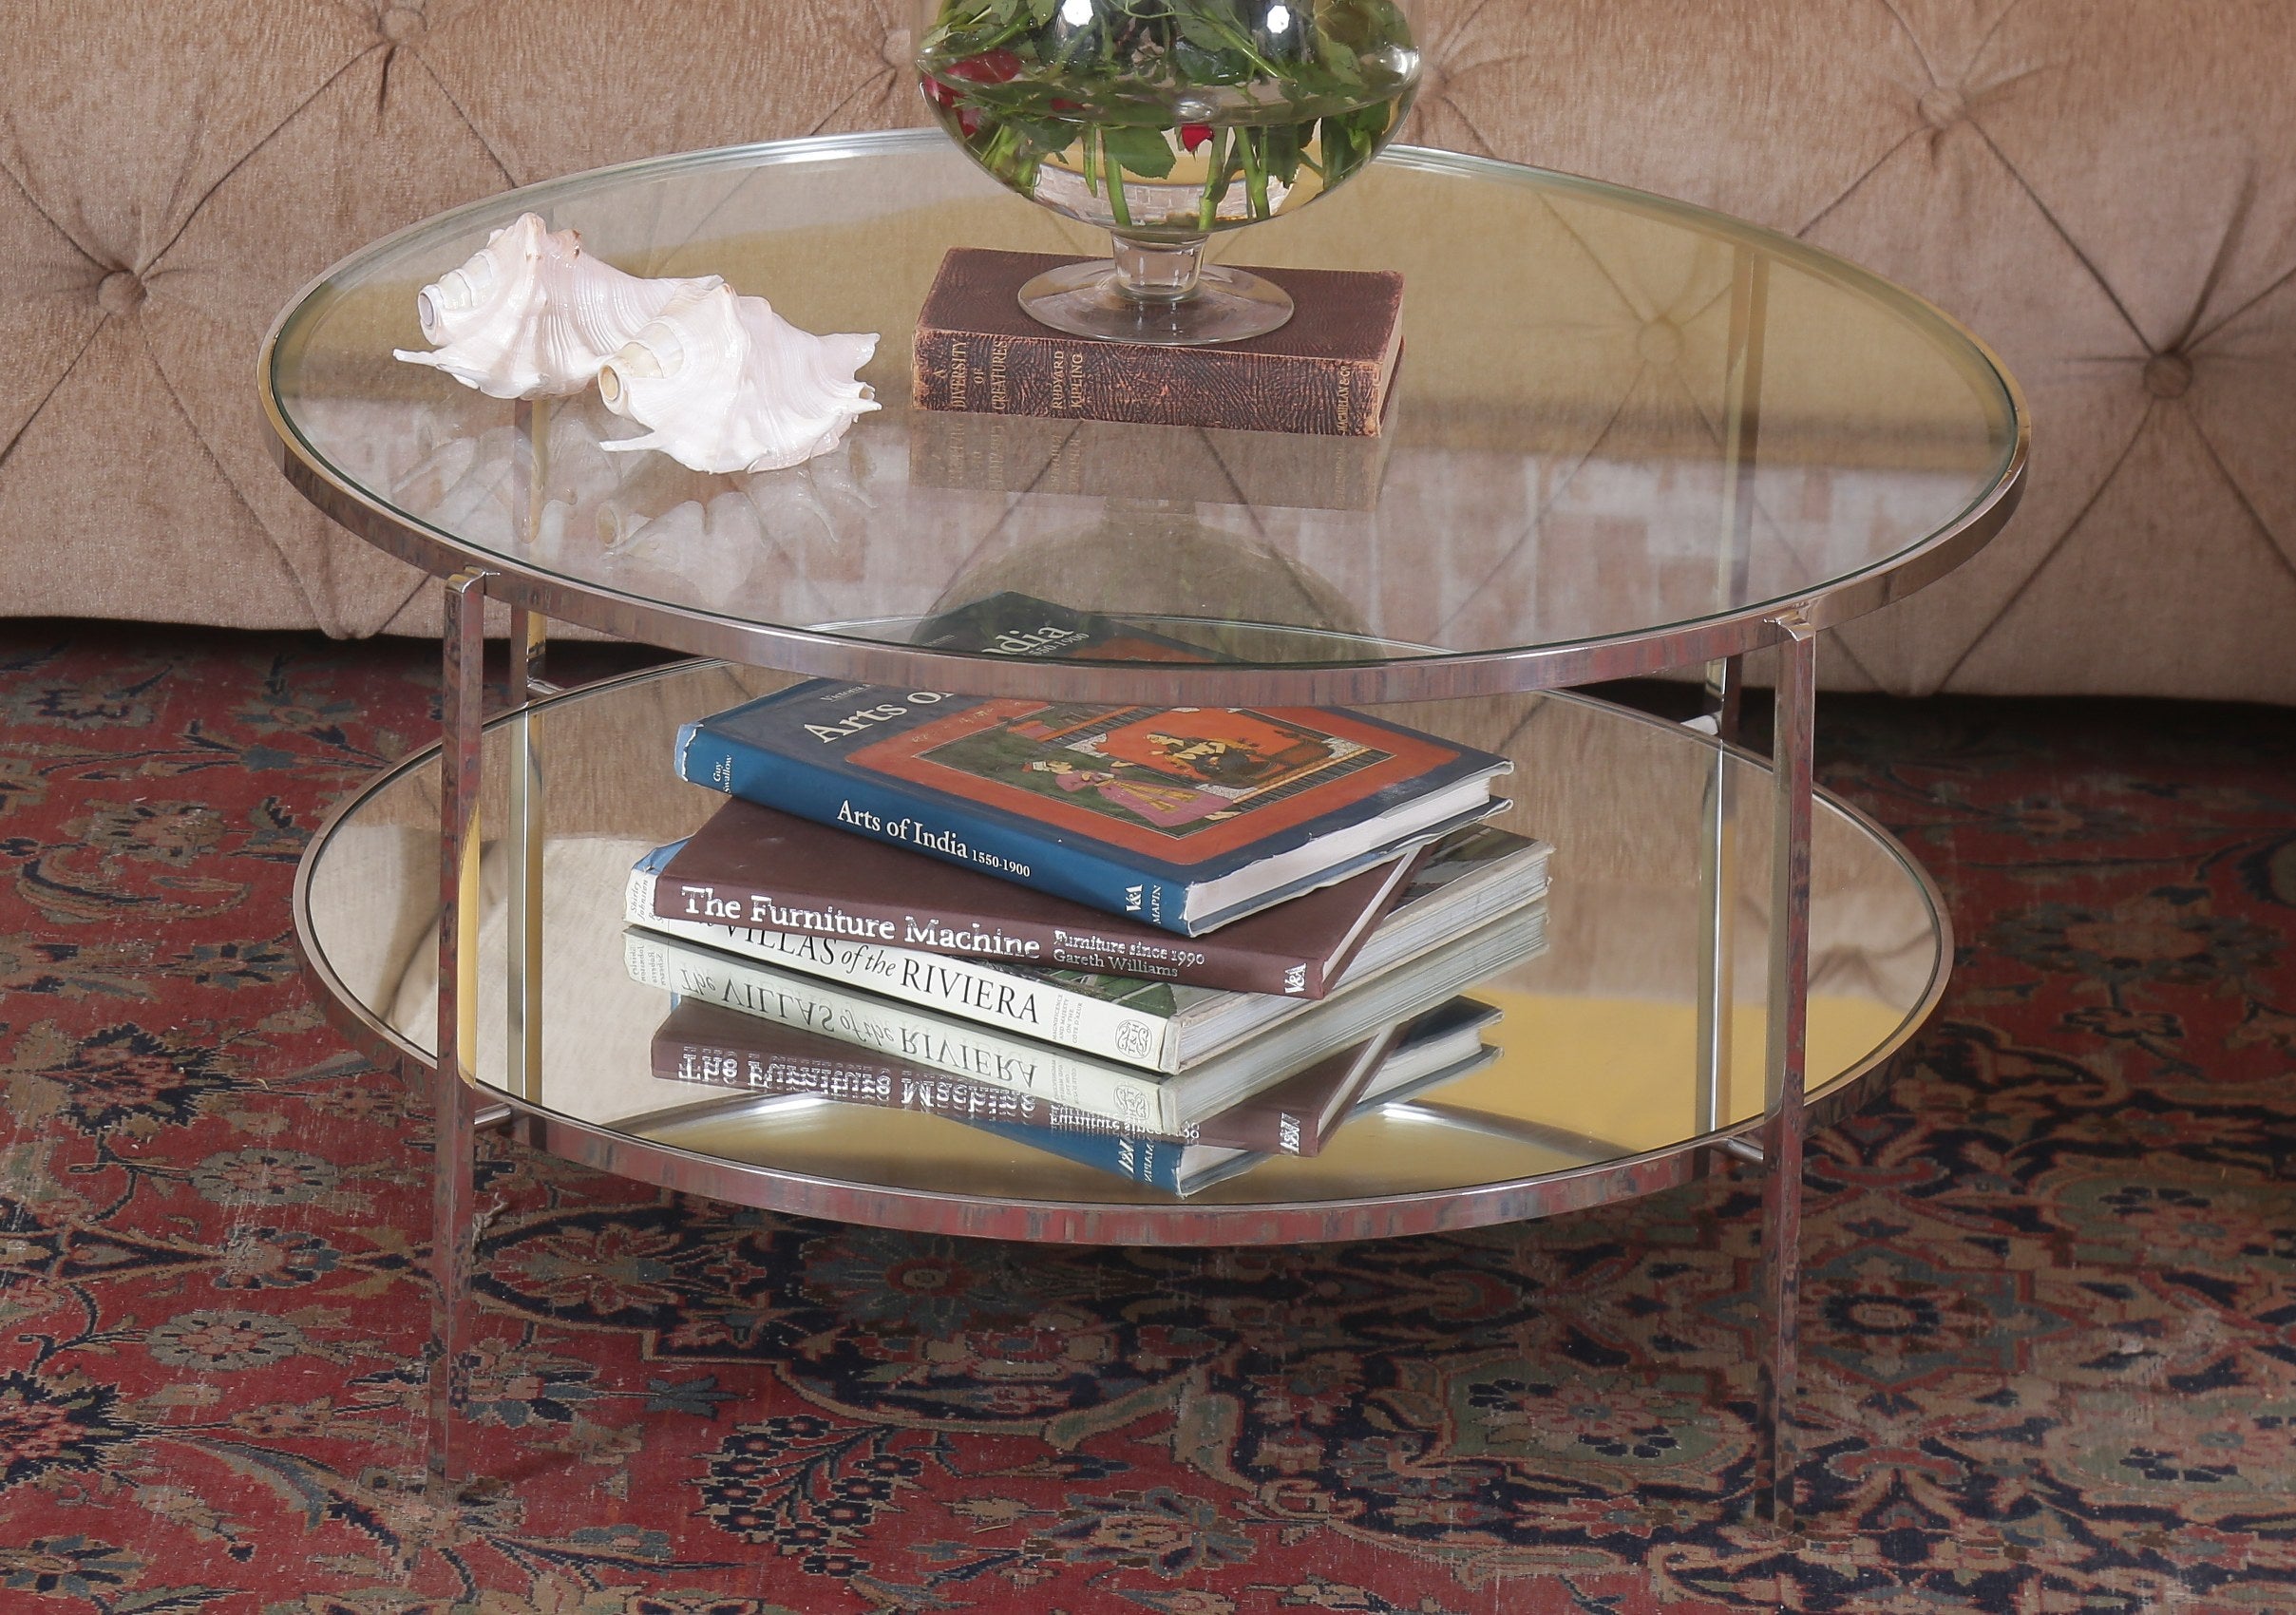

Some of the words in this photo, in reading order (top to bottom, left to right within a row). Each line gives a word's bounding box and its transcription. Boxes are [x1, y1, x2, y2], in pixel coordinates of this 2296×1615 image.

[951, 340, 967, 408] DIVERSITY
[974, 367, 985, 385] OF
[991, 340, 1009, 410] CREATURES
[1052, 351, 1065, 410] RUDYARD
[1071, 352, 1084, 408] KIPLING
[1028, 633, 1090, 656] 550-1900
[804, 704, 908, 744] Arts
[712, 761, 723, 782] Guy
[837, 799, 881, 832] Arts
[886, 818, 911, 840] of
[913, 821, 968, 859] India
[972, 849, 1031, 878] 1550-1900
[631, 881, 641, 913] Shirley
[1151, 884, 1162, 924] MAPIN
[681, 885, 741, 920] The
[750, 895, 896, 940] Furniture
[904, 915, 1041, 960] Machine
[1053, 929, 1126, 956] Furniture
[1129, 941, 1168, 960] since
[1171, 949, 1205, 968] 1990
[1053, 948, 1105, 968] Gareth
[1108, 956, 1179, 978] Williams
[841, 945, 869, 974] of
[864, 950, 897, 977] the
[900, 958, 1040, 1025] RIVIERA
